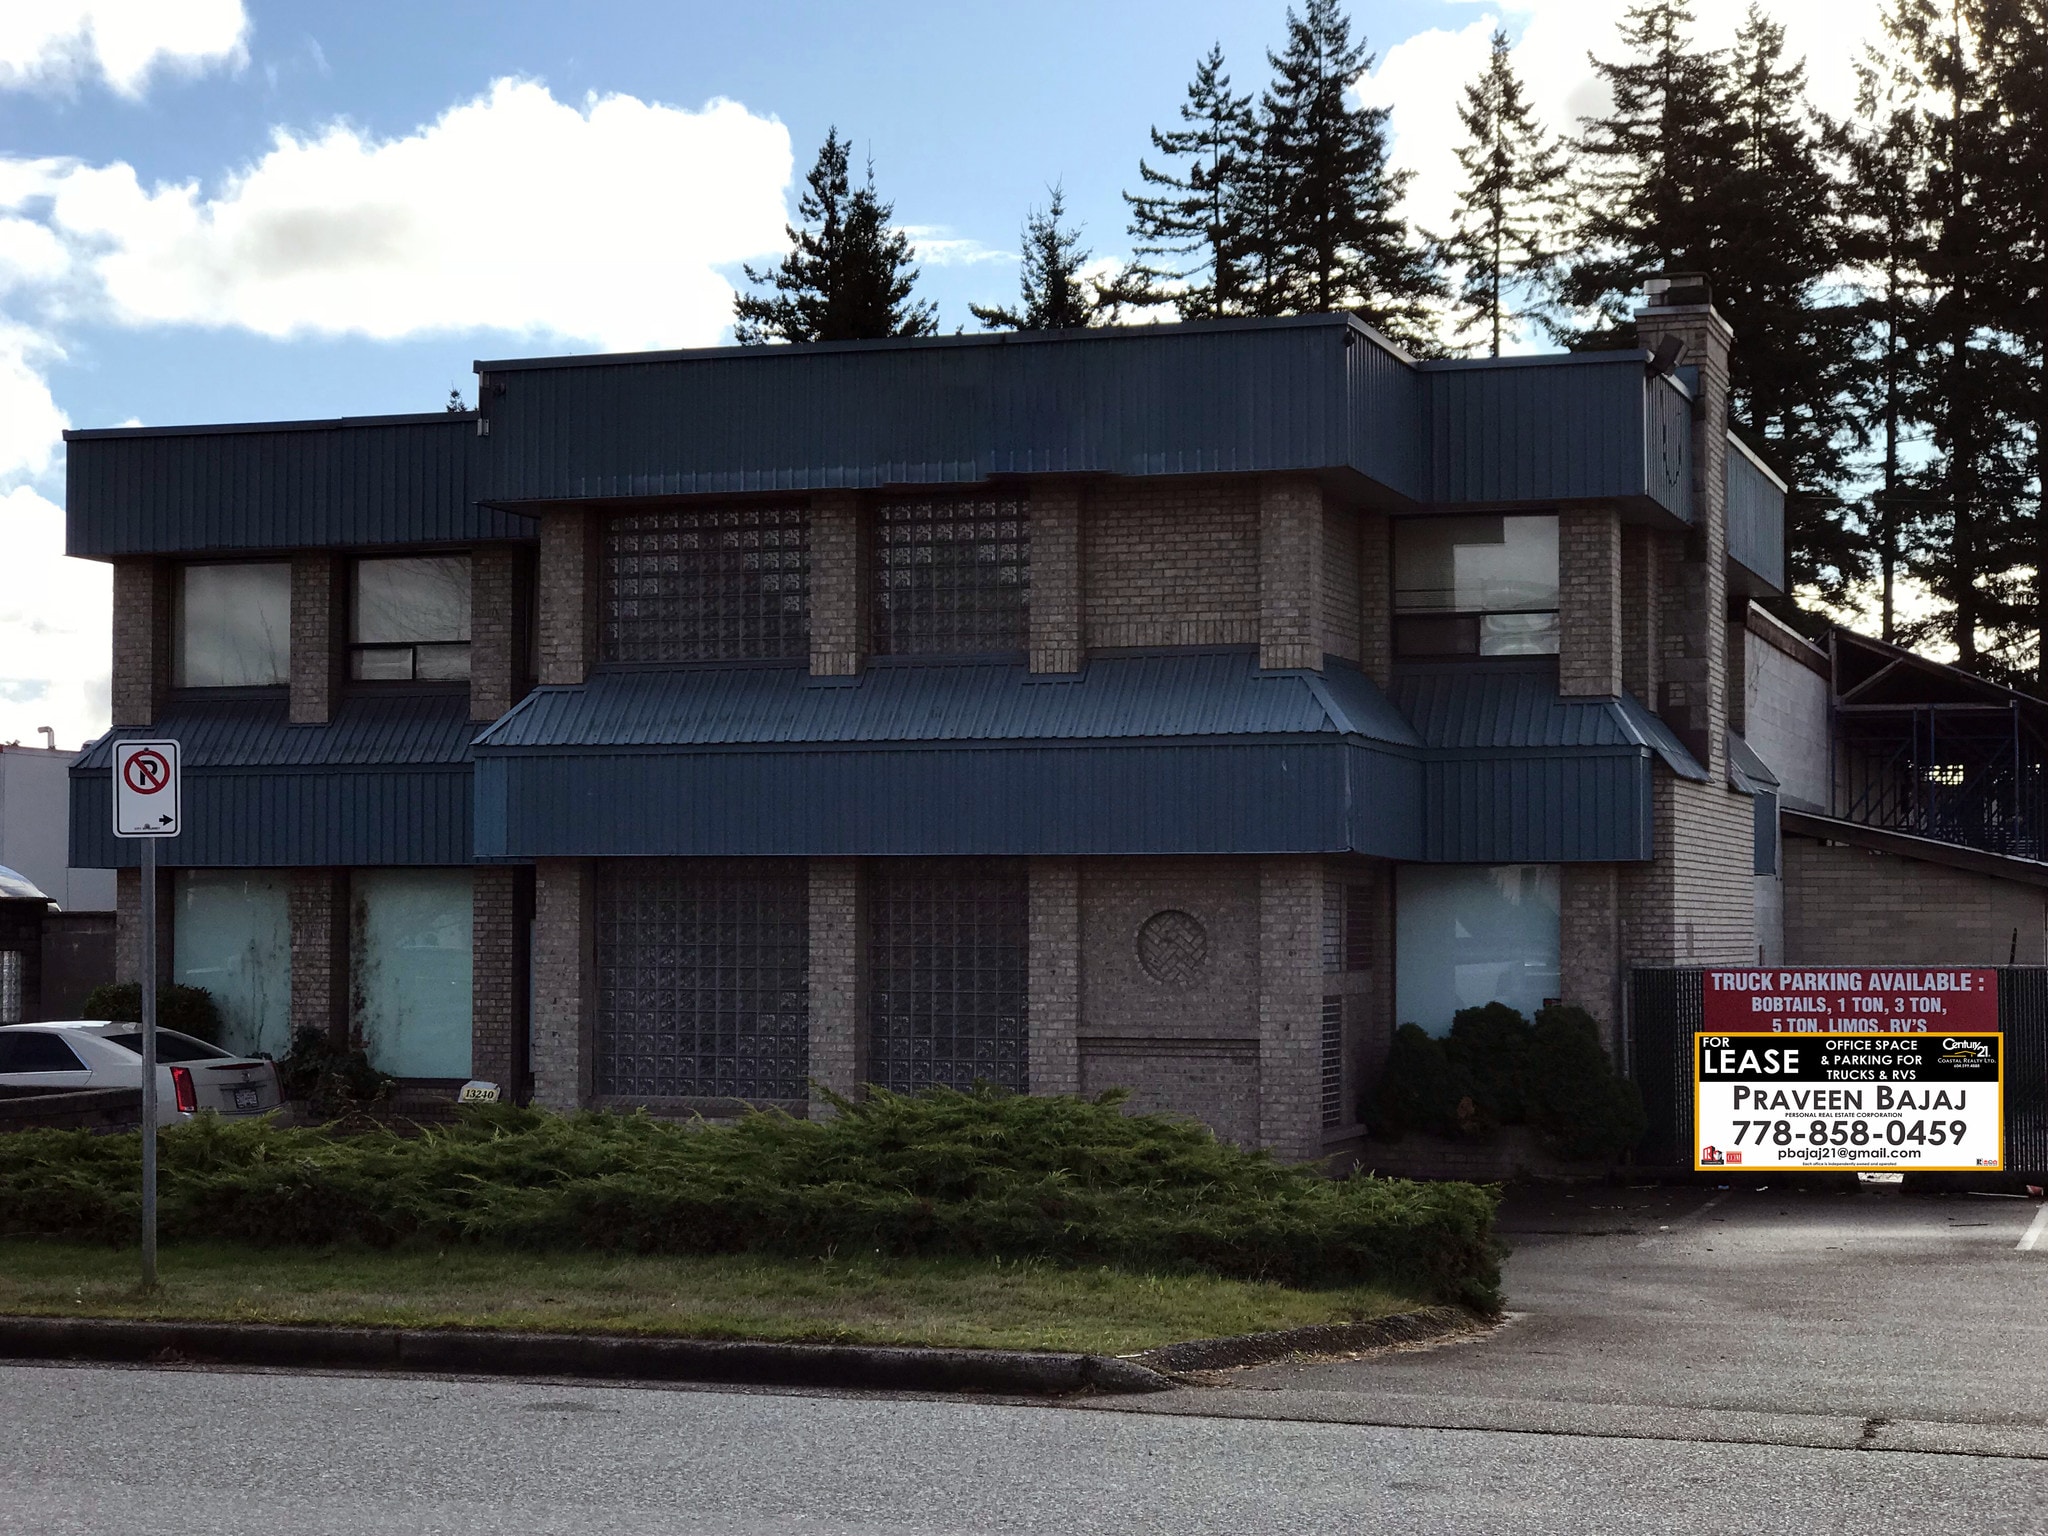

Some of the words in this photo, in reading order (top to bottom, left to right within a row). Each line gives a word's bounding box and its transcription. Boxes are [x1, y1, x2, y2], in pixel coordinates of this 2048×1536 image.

[1711, 972, 1774, 991] TRUCK
[1780, 972, 1862, 991] PARKING
[1868, 972, 1972, 991] AVAILABLE
[1751, 996, 1832, 1015] BOBTAILS,
[1837, 997, 1846, 1012] 1
[1851, 997, 1889, 1015] TON,
[1894, 997, 1905, 1013] 3
[1909, 997, 1947, 1015] TON,
[1772, 1018, 1782, 1032] 5
[1890, 1018, 1927, 1032] RV'S
[1703, 1037, 1730, 1048] FOR
[1825, 1040, 1872, 1051] OFFICE
[1875, 1040, 1918, 1051] SPACE
[1704, 1048, 1799, 1074] LEASE
[1820, 1055, 1830, 1065] &
[1834, 1055, 1893, 1065] PARKING
[1897, 1055, 1922, 1065] FOR
[1826, 1069, 1875, 1080] TRUCKS
[1879, 1070, 1888, 1080] &
[1892, 1069, 1916, 1080] RVS
[465, 1089, 494, 1099] 13240
[1733, 1085, 1863, 1111] PRAVEEN
[1876, 1085, 1967, 1111] BAJAJ
[1732, 1119, 1968, 1146] 778-858-0459
[1778, 1147, 1922, 1161] pbajaj21@gmail.com
